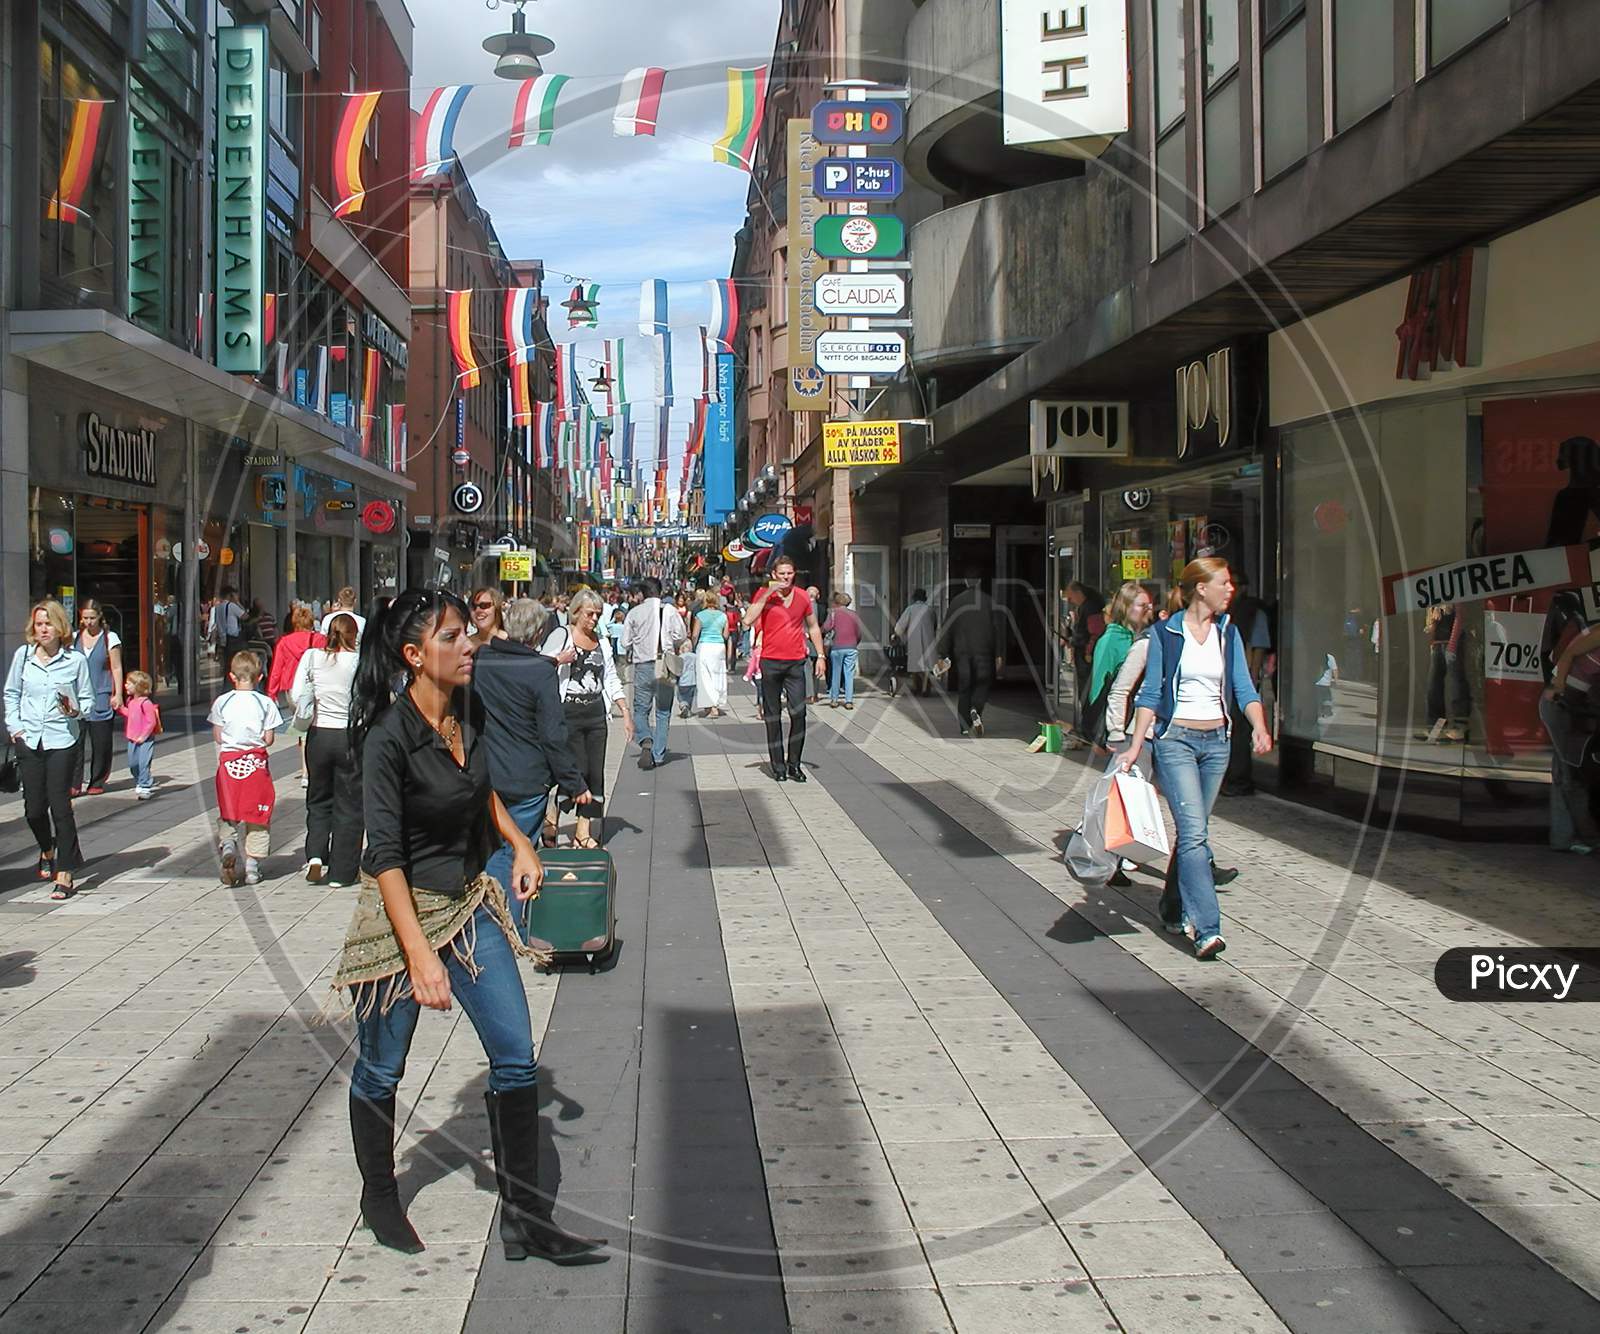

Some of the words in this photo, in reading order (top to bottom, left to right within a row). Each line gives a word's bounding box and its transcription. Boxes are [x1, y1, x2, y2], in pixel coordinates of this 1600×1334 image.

[828, 111, 888, 132] OHIO
[856, 166, 890, 178] P-hus
[856, 178, 881, 190] Pub
[224, 47, 253, 349] DEBENHAMS
[719, 386, 731, 417] kontor
[825, 428, 844, 438] 50%
[846, 425, 857, 437] PÅ
[860, 426, 895, 437] MASSOR
[88, 412, 156, 485] STADIUM
[837, 438, 849, 448] AV
[244, 455, 280, 466] STADIUM
[827, 450, 847, 463] ALLA
[1416, 554, 1535, 608] SLUTREA
[1490, 641, 1540, 669] 70%
